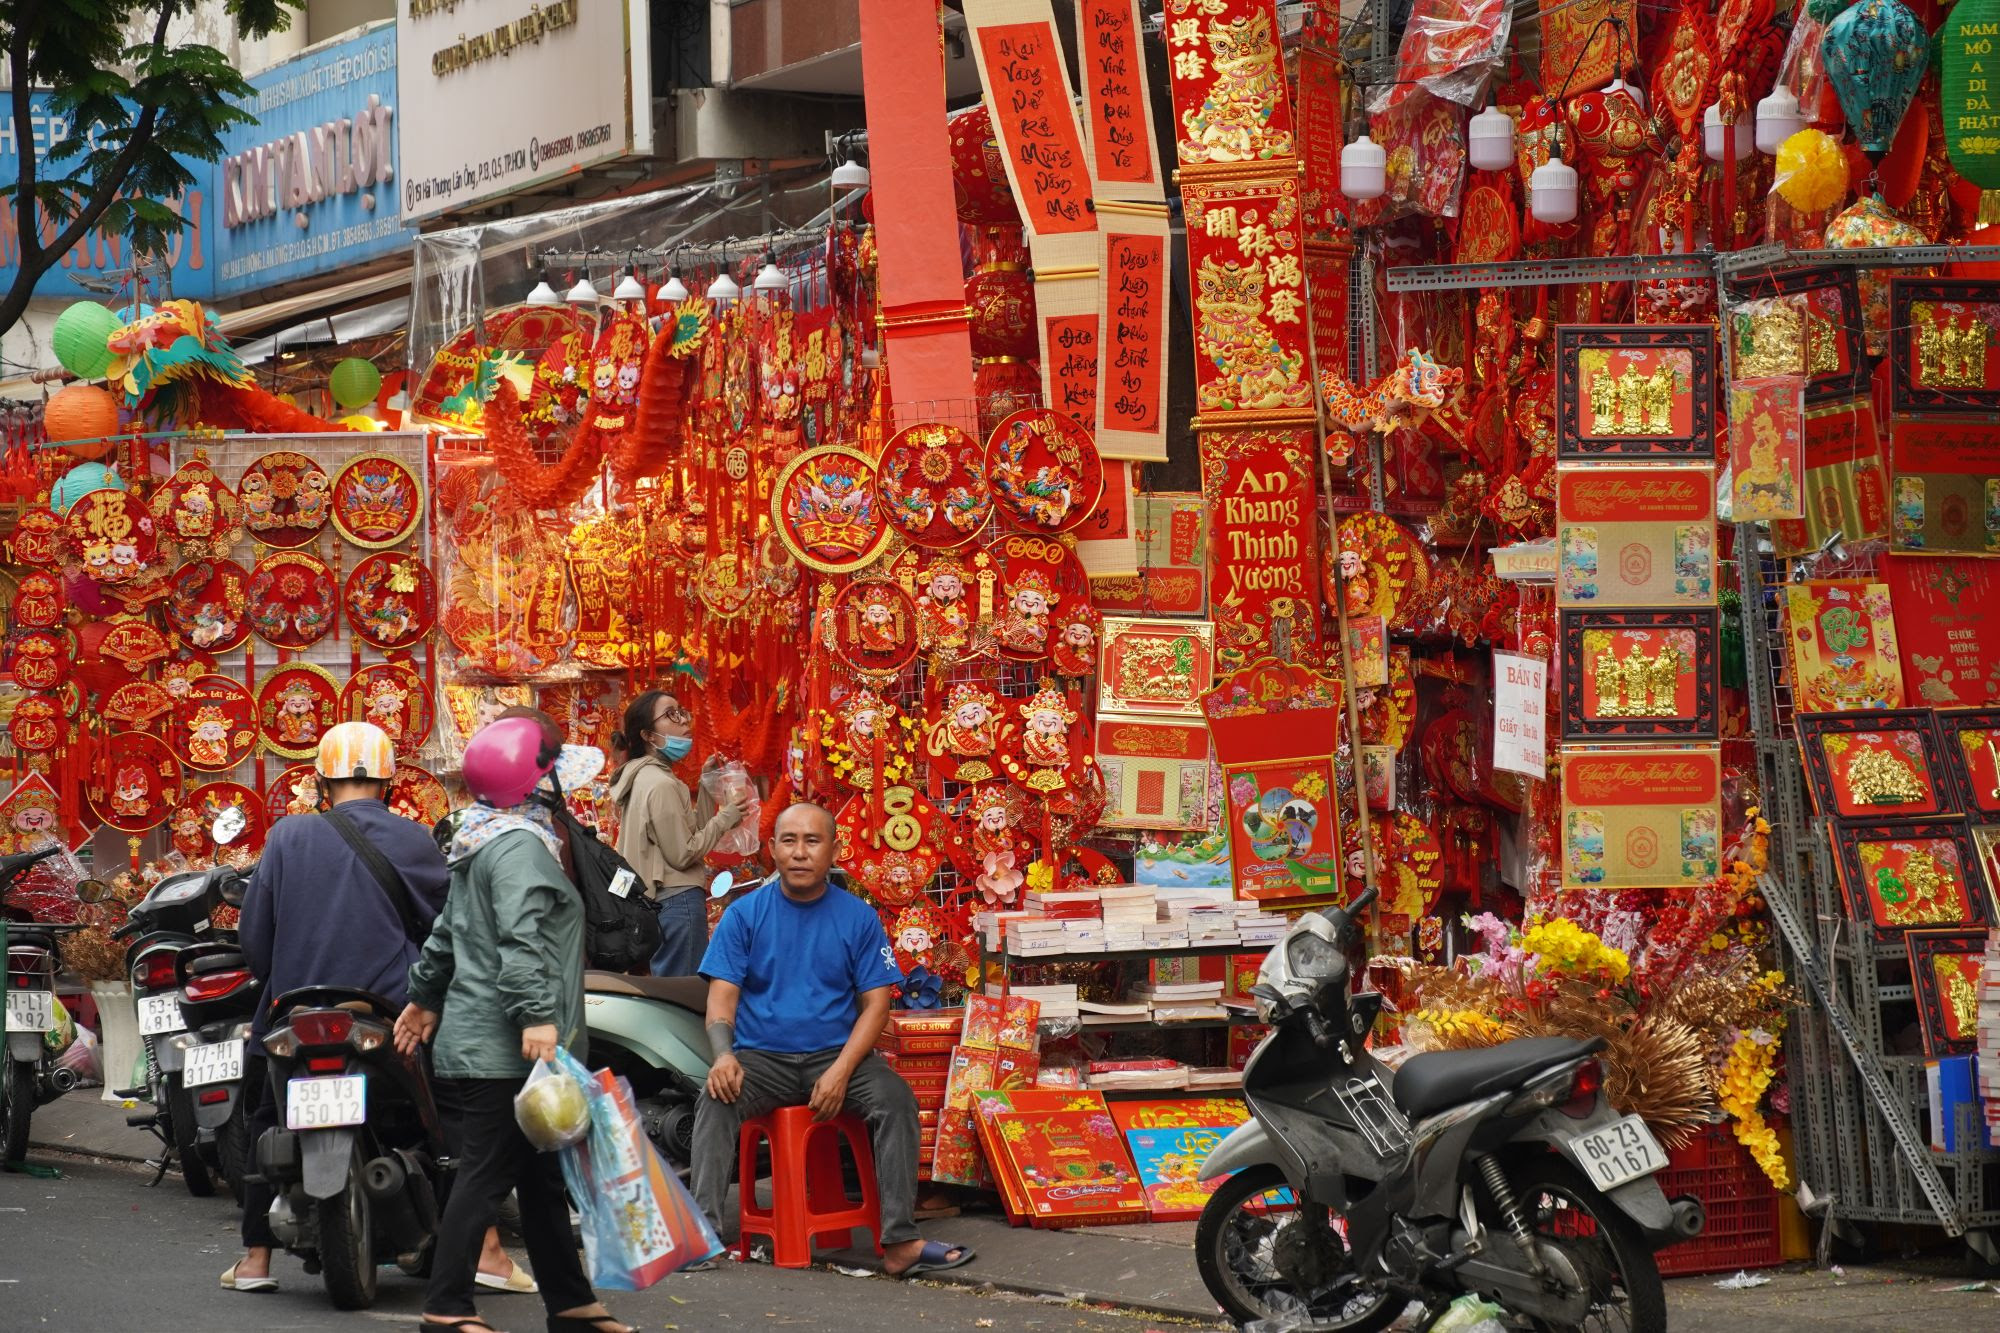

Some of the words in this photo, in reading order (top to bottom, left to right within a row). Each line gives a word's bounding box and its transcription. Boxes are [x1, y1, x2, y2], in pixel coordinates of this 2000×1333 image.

[1094, 9, 1123, 32] Năm
[1960, 23, 1998, 36] NAM
[1098, 32, 1124, 54] Mới
[1965, 40, 1992, 55] MÔ
[1002, 60, 1042, 86] Vàng
[1971, 61, 1983, 73] A
[1968, 79, 1987, 92] DI
[1966, 92, 1991, 110] ĐÀ
[223, 142, 277, 228] KIM
[274, 122, 336, 230] VẠN
[335, 94, 393, 210] LỢI
[1035, 171, 1071, 195] Năm
[1046, 198, 1081, 221] Mới
[1234, 467, 1288, 494] An
[85, 490, 132, 538] 福
[1225, 496, 1299, 527] Khang
[803, 526, 867, 548] 龍年大吉
[1228, 529, 1298, 566] Thịnh
[1227, 563, 1302, 594] Vượng
[28, 601, 50, 618] Tài
[1950, 642, 1980, 654] MỪNG
[1956, 655, 1979, 666] NĂM
[1506, 664, 1530, 687] BÁN
[1961, 668, 1980, 680] MỚI
[26, 725, 46, 741] Lộc
[1413, 850, 1439, 864] Vạn
[1418, 879, 1440, 888] Như
[906, 1022, 927, 1032] CHÚC
[192, 1041, 233, 1065] 77-H1
[911, 1039, 932, 1049] CHÚC
[186, 1061, 239, 1085] 317.39
[300, 1079, 353, 1102] 59-V3
[293, 1101, 359, 1126] 150.12
[1583, 1122, 1640, 1160] 60-Z3
[1598, 1144, 1651, 1182] 0167
